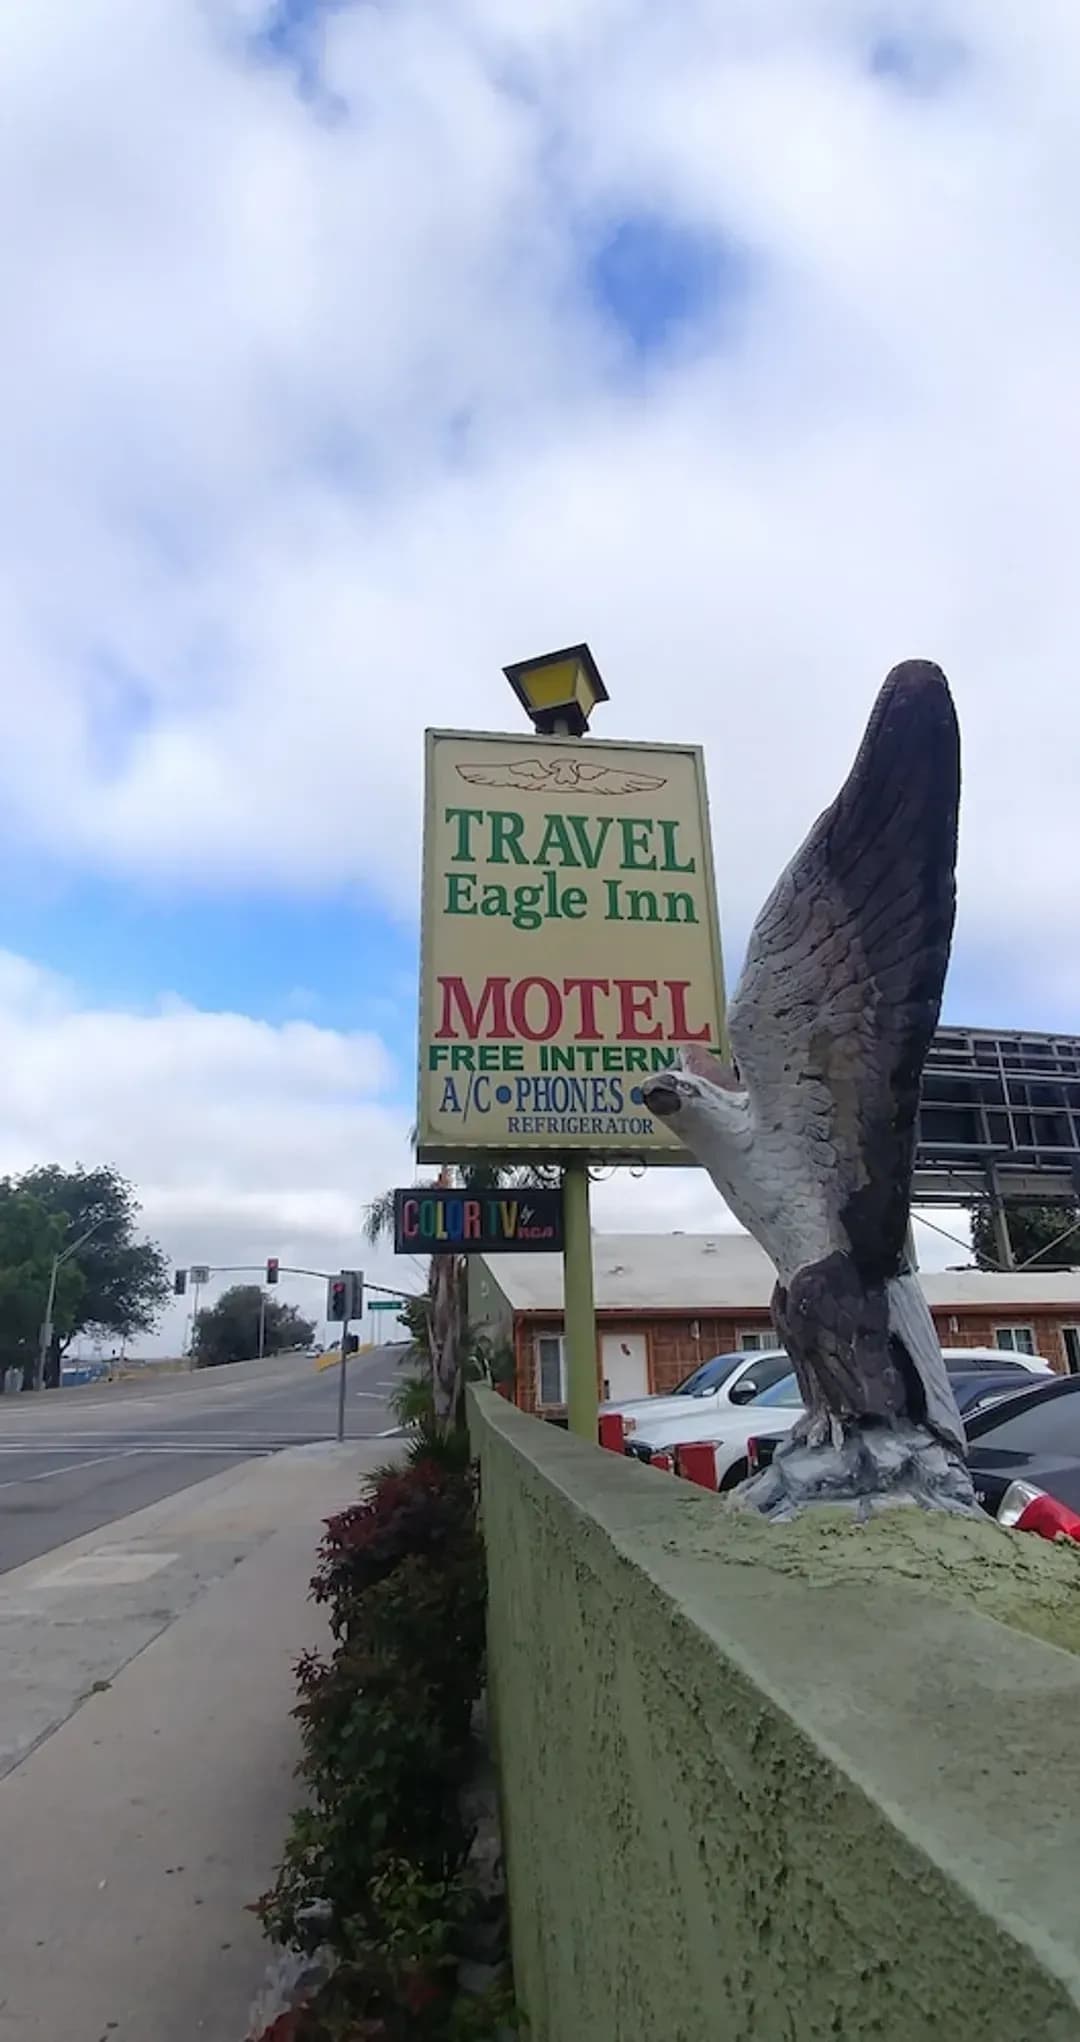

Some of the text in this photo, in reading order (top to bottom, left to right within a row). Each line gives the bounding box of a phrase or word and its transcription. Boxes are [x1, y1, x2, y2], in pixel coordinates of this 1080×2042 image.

[445, 808, 696, 873] TRAVEL
[443, 871, 699, 930] Eagle Inn
[434, 976, 711, 1042] MOTEL
[428, 1045, 721, 1074] FREE INTERN
[515, 1076, 624, 1115] PHONES
[508, 1116, 654, 1135] REFRIGERATOR
[403, 1199, 481, 1242] COLOR
[487, 1200, 519, 1240] TV
